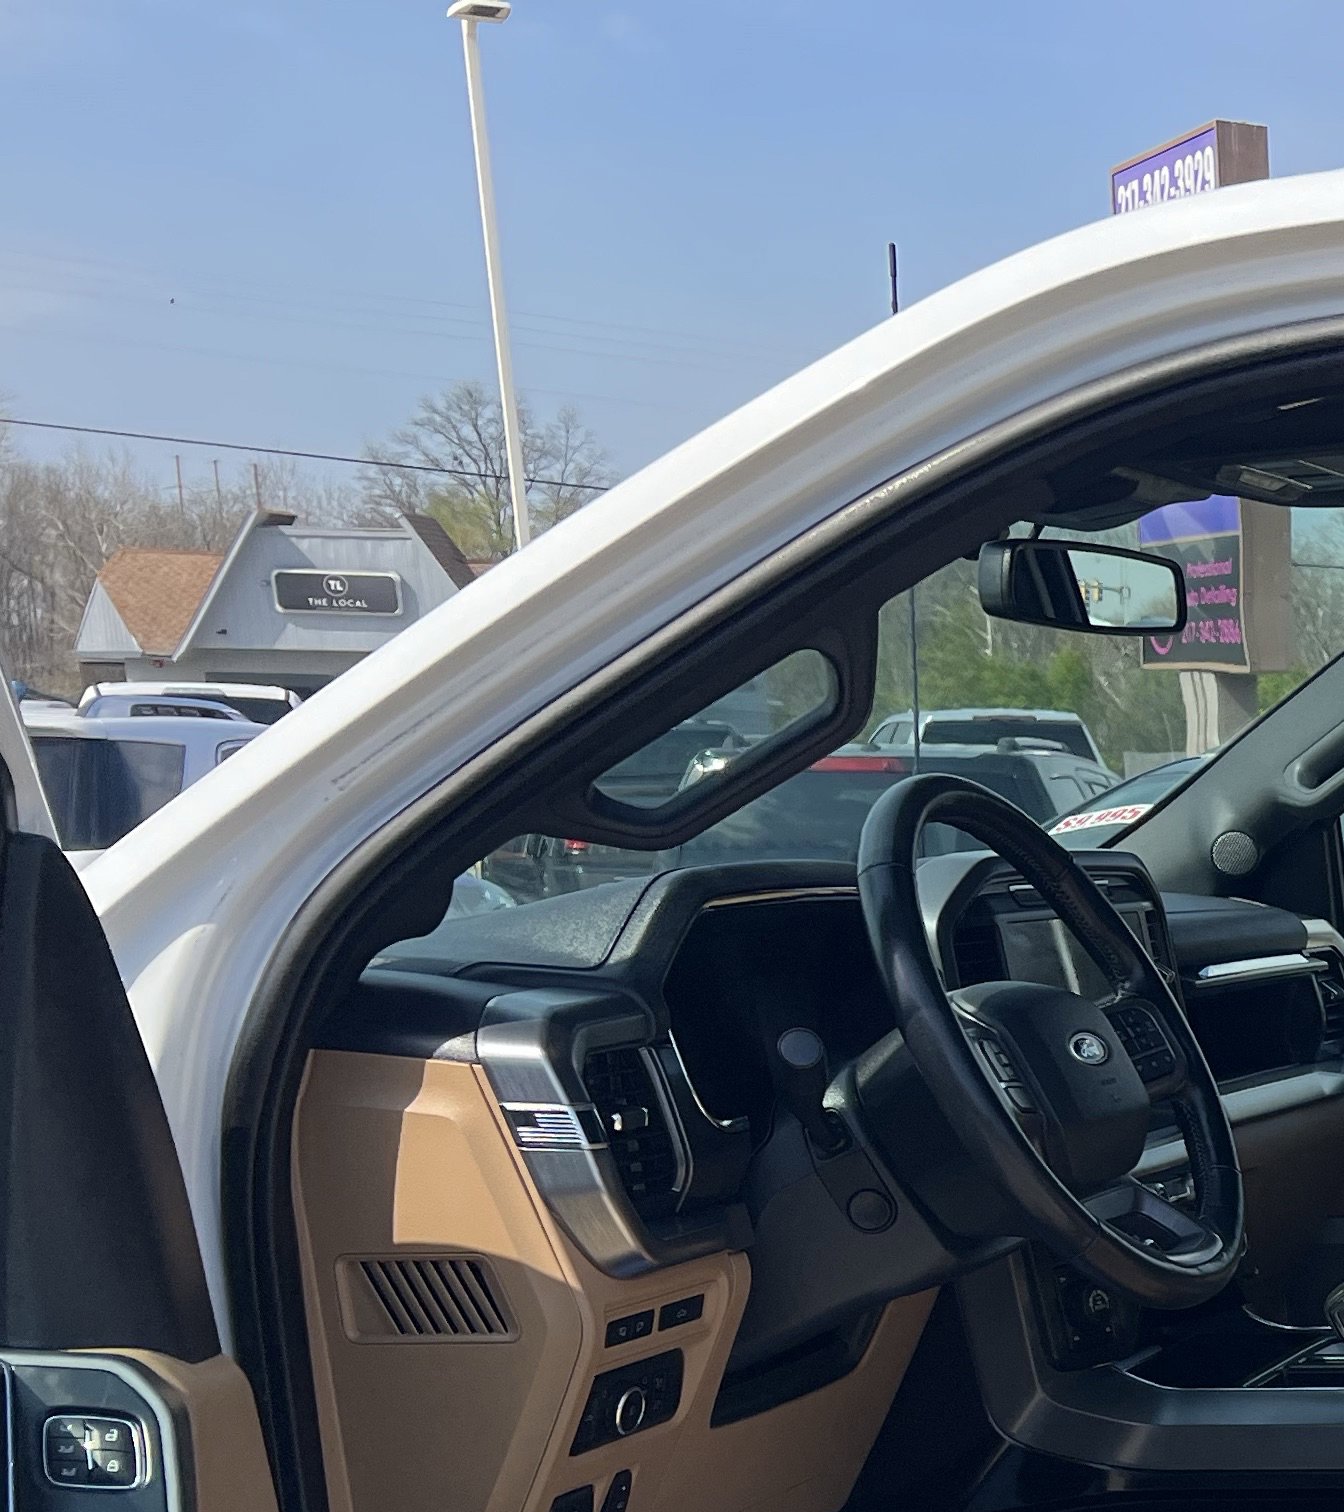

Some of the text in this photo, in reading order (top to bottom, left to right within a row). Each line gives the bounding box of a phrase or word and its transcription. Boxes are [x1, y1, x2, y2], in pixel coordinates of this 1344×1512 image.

[327, 579, 344, 591] TL
[307, 597, 368, 608] THE LOCAL
